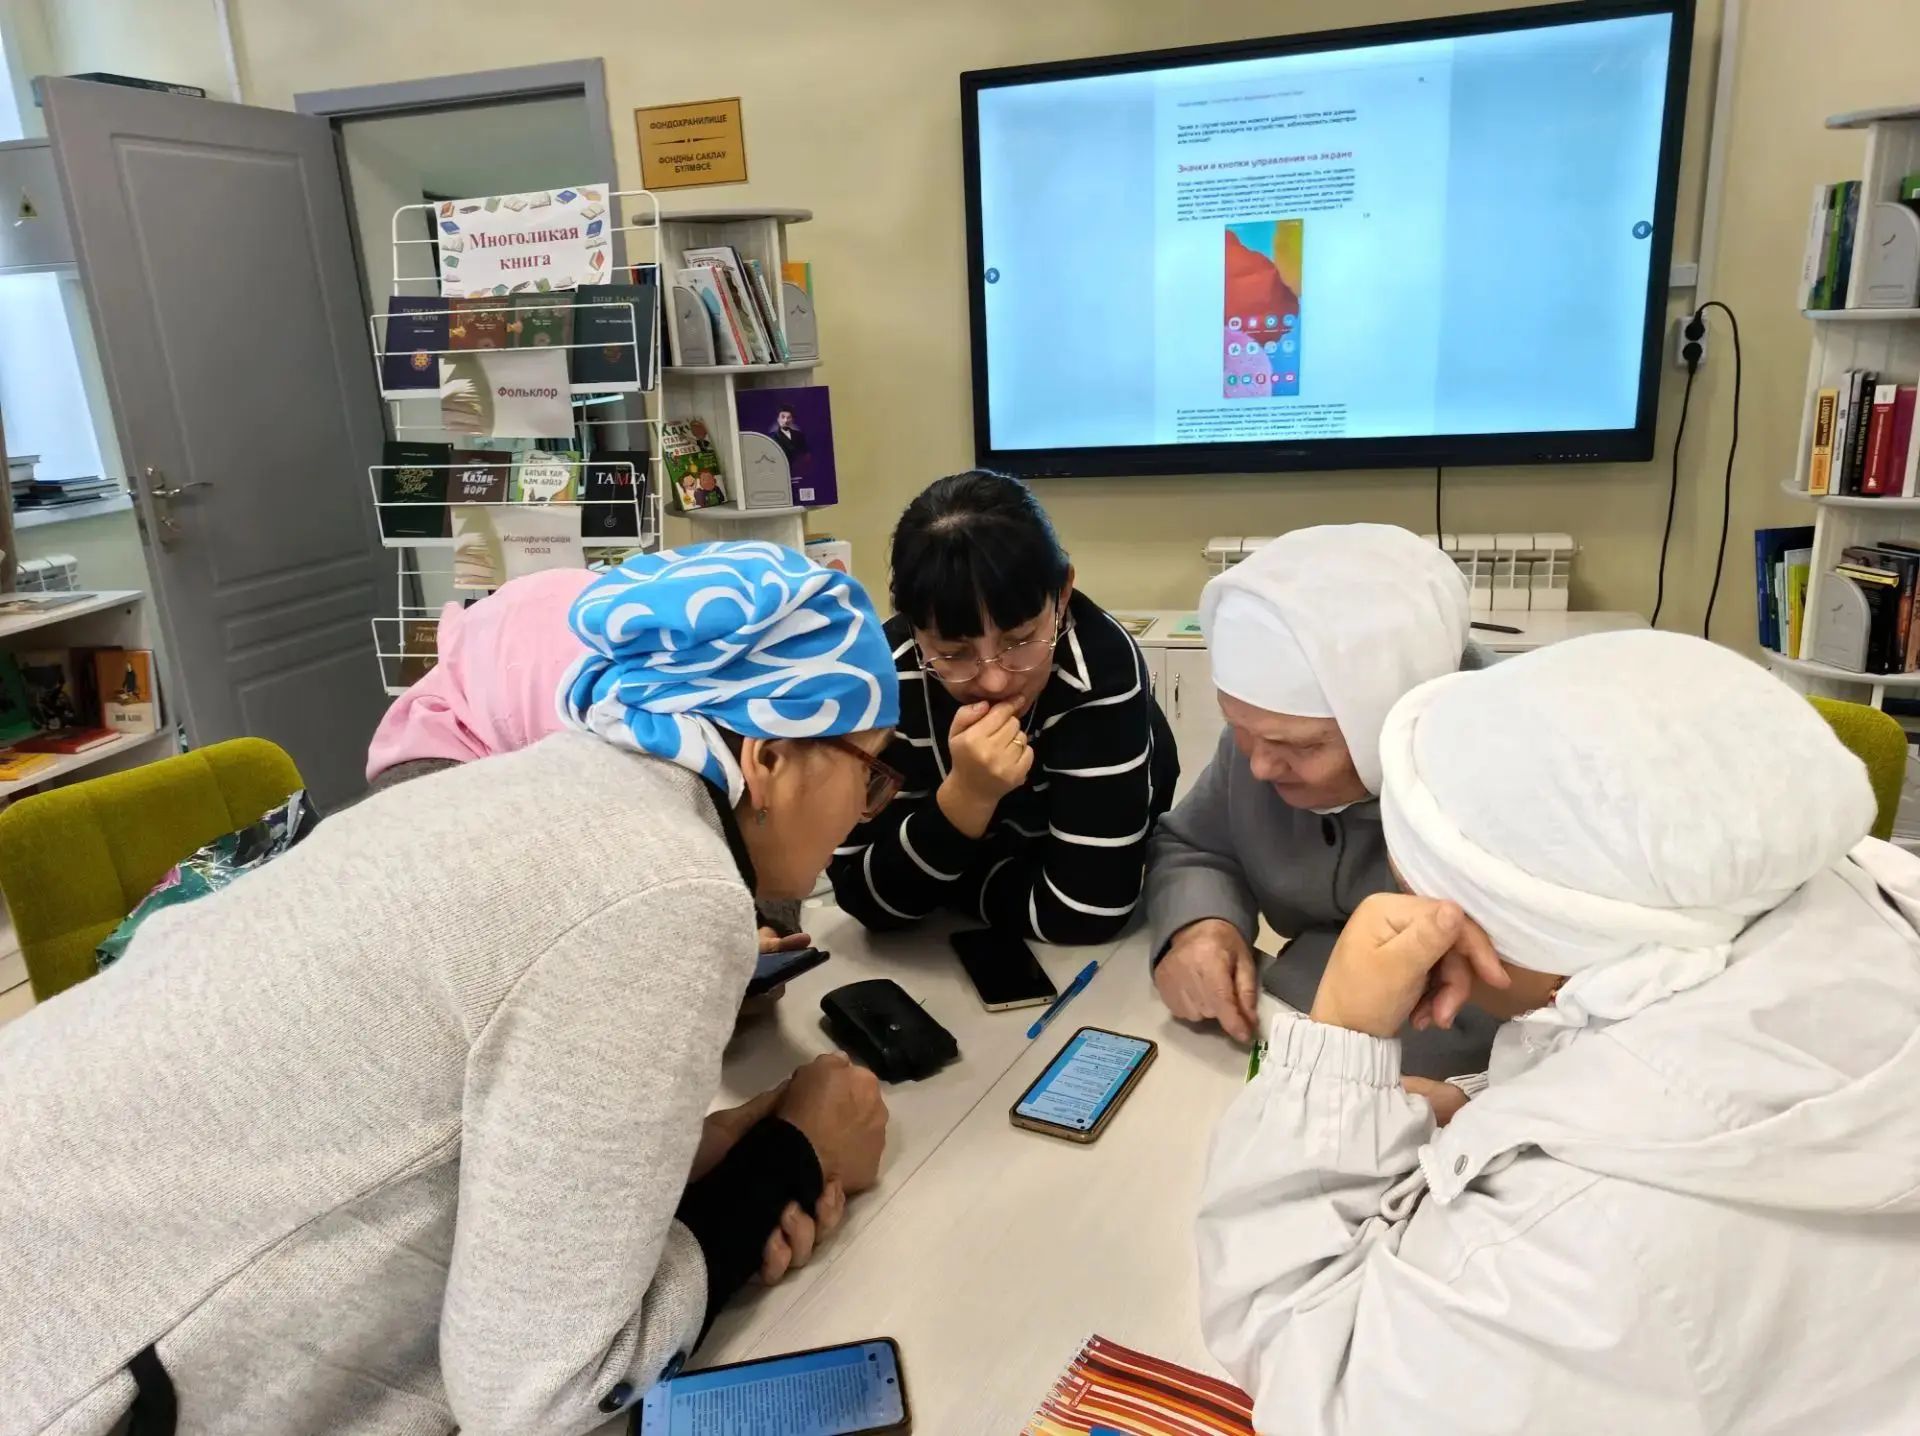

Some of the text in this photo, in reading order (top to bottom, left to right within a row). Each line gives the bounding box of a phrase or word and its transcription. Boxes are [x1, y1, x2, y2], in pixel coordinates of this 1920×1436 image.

[650, 114, 727, 129] ФОНДОХРАНИЛИЩЕ
[658, 151, 727, 164] ФОНДНЫ САКЛАУ
[1178, 163, 1208, 173] Значки
[1218, 160, 1249, 169] кнопки
[1251, 155, 1305, 168] управления
[1321, 151, 1353, 160] экране
[470, 227, 579, 249] Многоликая
[500, 254, 551, 270] книга
[497, 386, 558, 399] Фольклор
[503, 534, 571, 543] Историческая
[524, 547, 551, 555] проза
